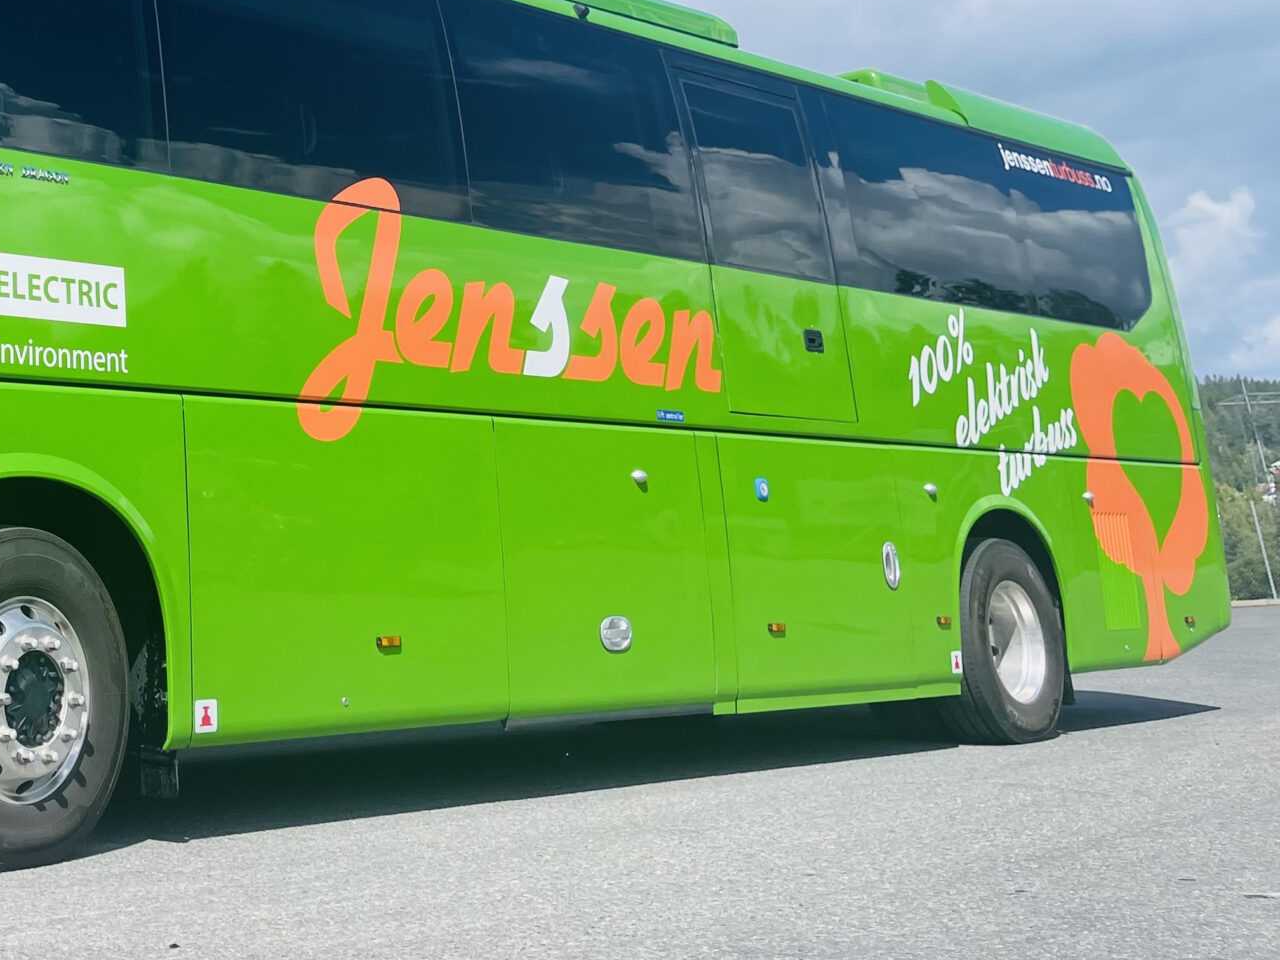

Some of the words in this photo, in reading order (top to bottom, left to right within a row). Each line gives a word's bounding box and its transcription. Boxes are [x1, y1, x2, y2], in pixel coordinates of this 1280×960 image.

[997, 143, 1113, 193] jenssenturbuss.no
[296, 177, 722, 442] Jenssen
[908, 306, 974, 408] 100%
[955, 327, 1049, 448] elektrisk
[997, 405, 1077, 497] turbuss
